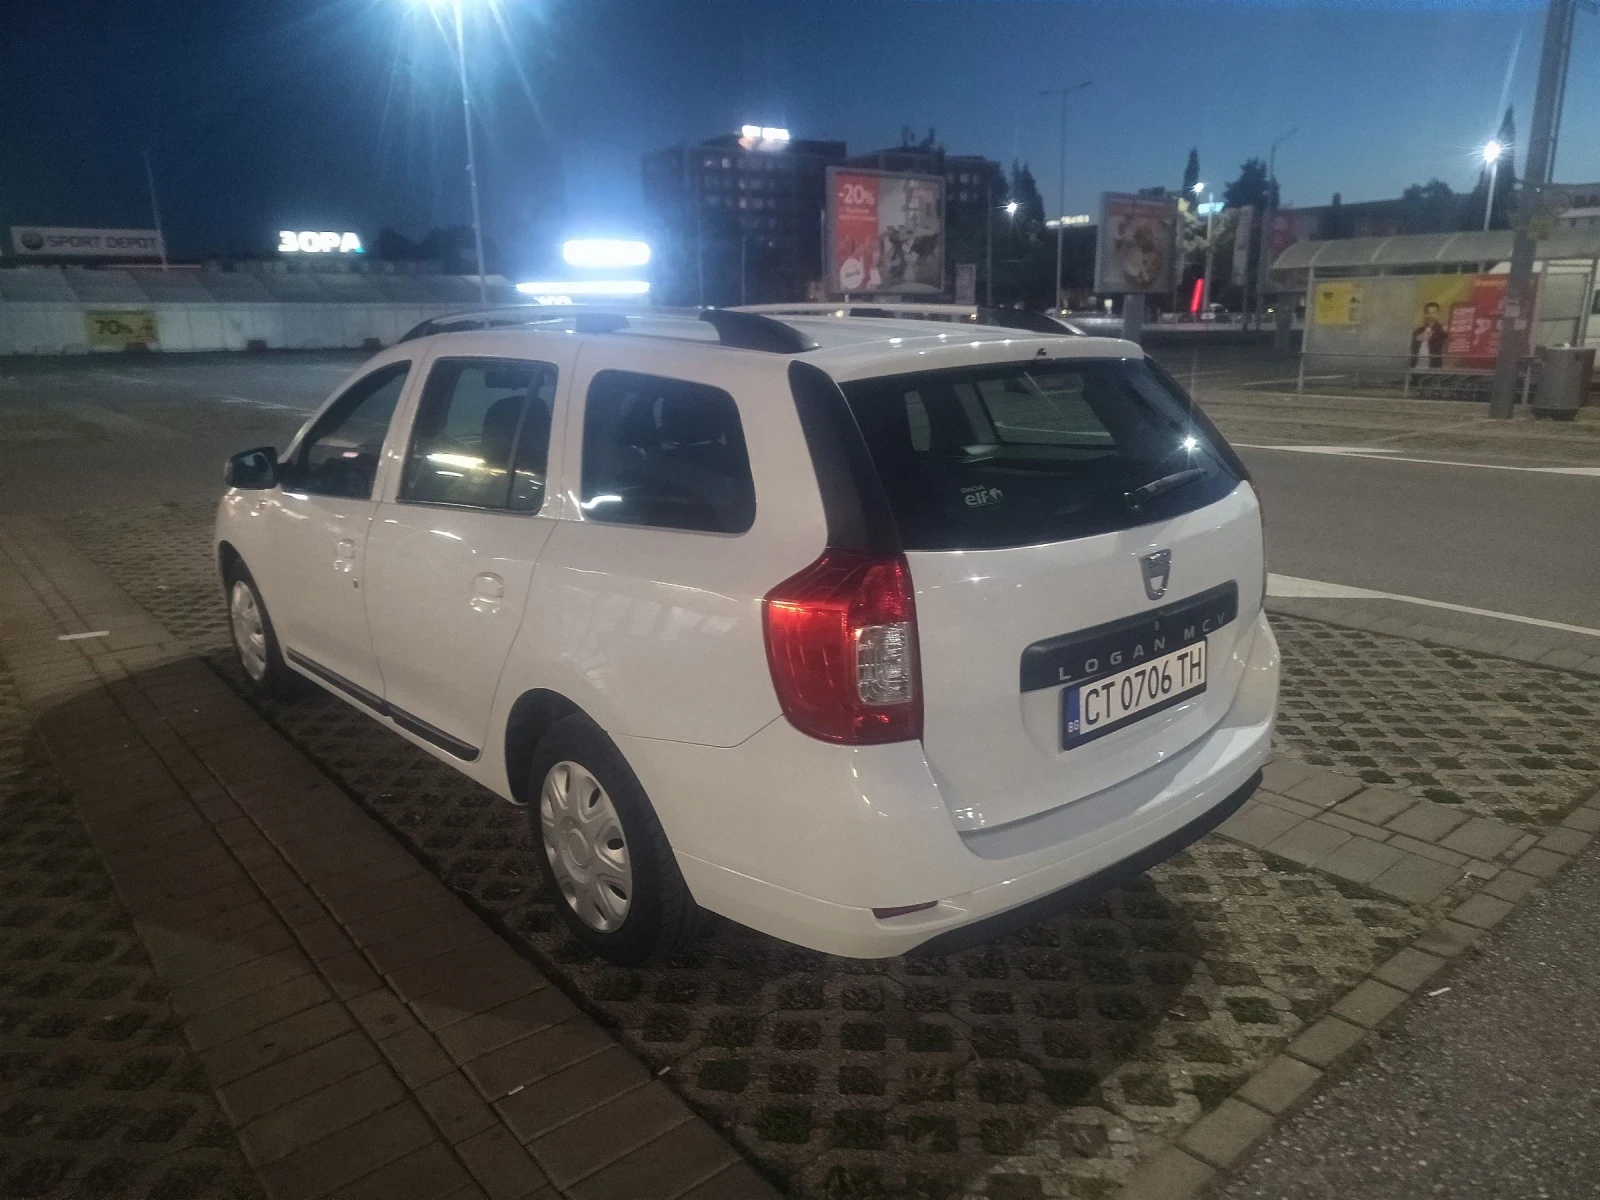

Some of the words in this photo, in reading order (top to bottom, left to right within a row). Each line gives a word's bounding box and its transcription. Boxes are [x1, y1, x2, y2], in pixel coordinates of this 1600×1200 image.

[49, 235, 101, 247] SPORT
[106, 236, 158, 249] DEPOT
[965, 490, 988, 505] elf
[1059, 638, 1166, 681] LOGAN
[1184, 612, 1226, 640] MCV
[1084, 681, 1116, 726] CT
[1120, 660, 1173, 711] 0706
[1177, 647, 1202, 688] TH
[1067, 719, 1080, 733] BG
